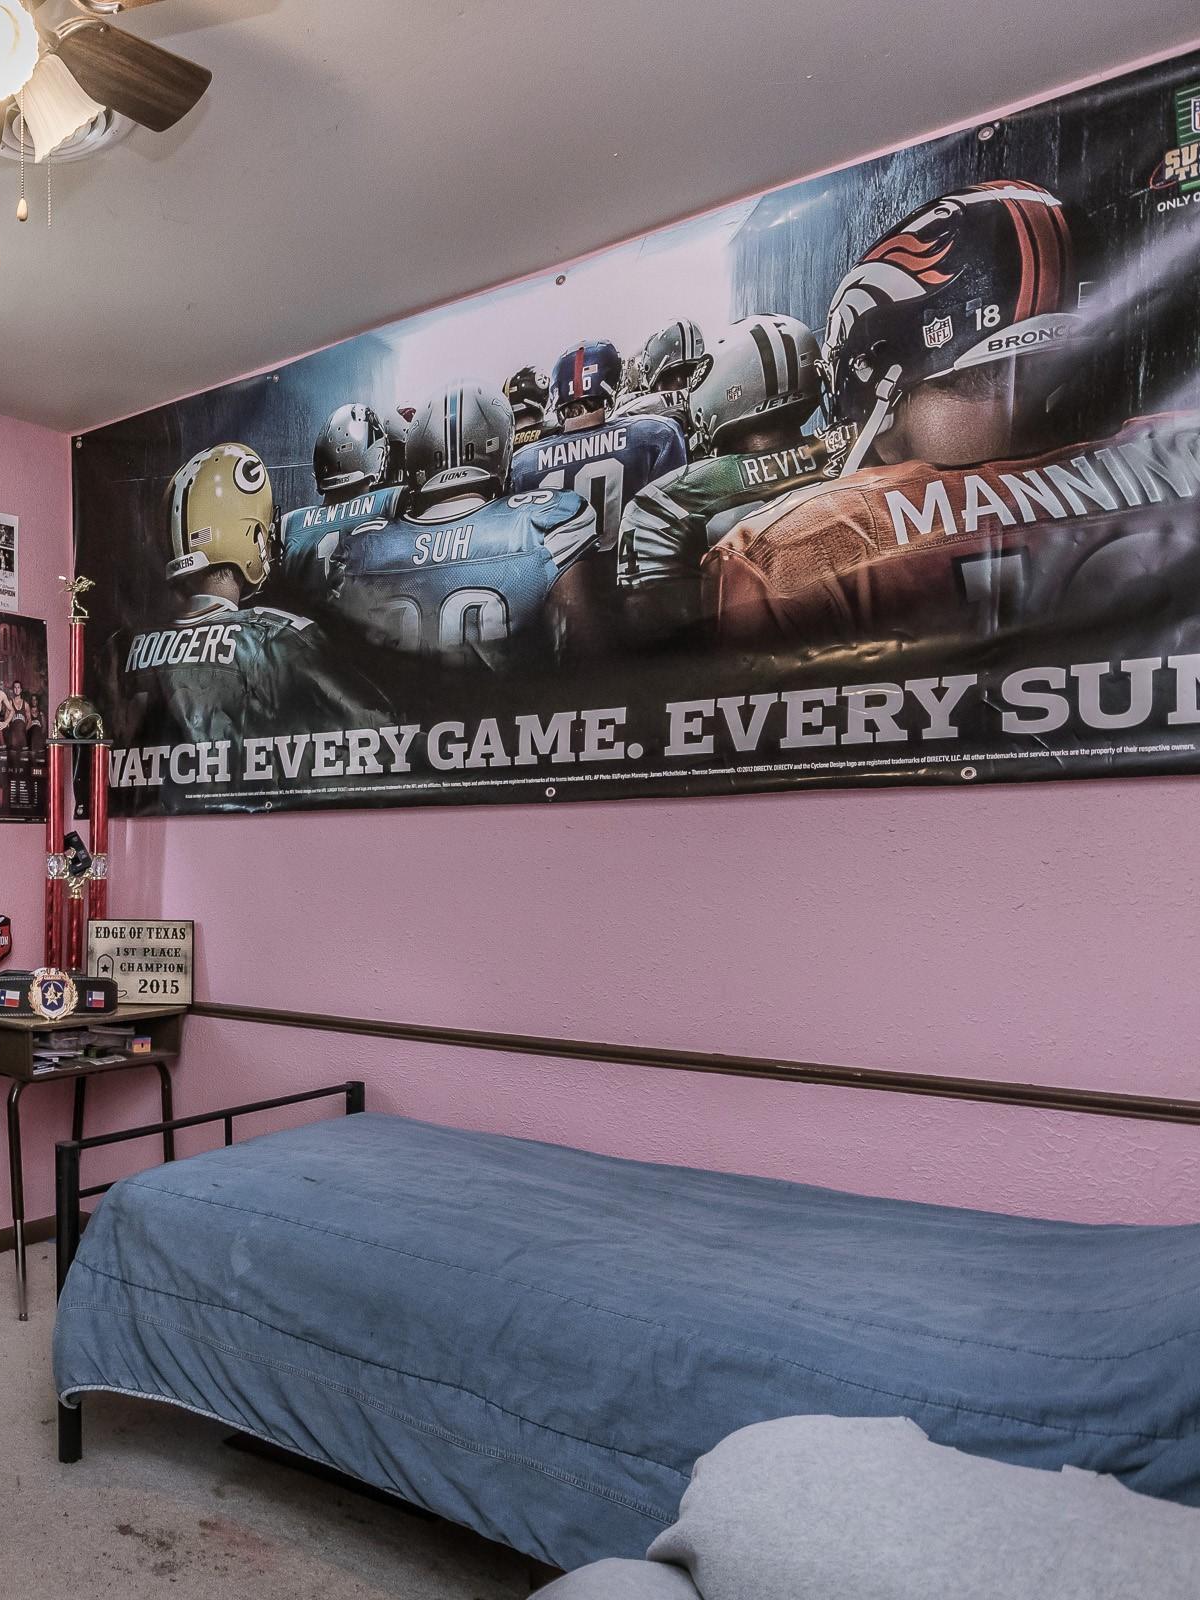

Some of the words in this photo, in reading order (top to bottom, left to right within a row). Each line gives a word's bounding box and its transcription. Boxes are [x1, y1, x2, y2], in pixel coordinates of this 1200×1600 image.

[1165, 143, 1200, 179] SU
[1157, 195, 1190, 212] ONLY
[975, 304, 1000, 331] 18
[928, 330, 950, 344] NFL
[988, 325, 1074, 351] BRONC
[538, 428, 627, 471] MANNING
[439, 471, 468, 484] LIONS
[742, 445, 816, 485] REVIS
[303, 496, 375, 527] NEWTON
[412, 525, 473, 565] SUH
[125, 624, 241, 672] RODGERS
[243, 724, 421, 781] EVERY
[428, 706, 644, 770] GAME.
[664, 674, 978, 757] EVERY
[1028, 751, 1049, 759] service
[1050, 749, 1068, 758] marks
[1138, 744, 1170, 752] respective
[95, 926, 126, 939] EDGE
[129, 927, 143, 939] OF
[147, 927, 186, 940] TEXAS
[116, 947, 136, 957] 1ST
[143, 947, 181, 957] PLACE
[120, 962, 184, 973] CHAMPION
[138, 979, 179, 994] 2015
